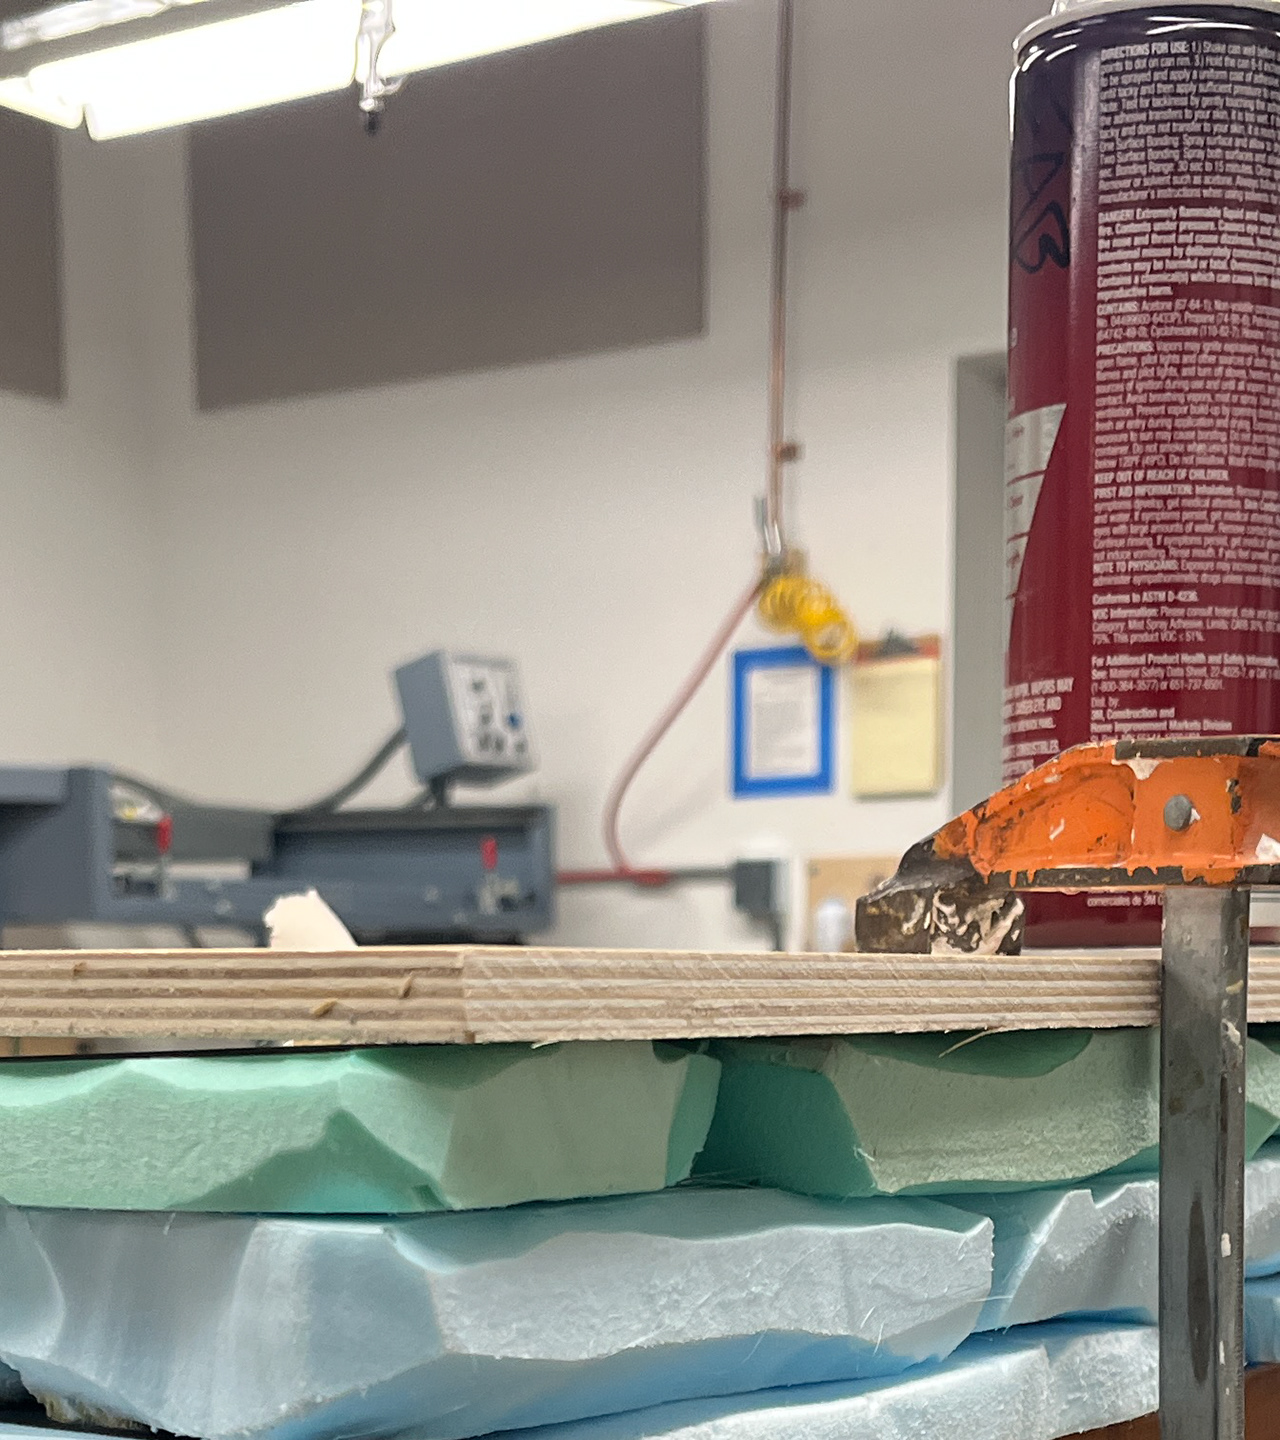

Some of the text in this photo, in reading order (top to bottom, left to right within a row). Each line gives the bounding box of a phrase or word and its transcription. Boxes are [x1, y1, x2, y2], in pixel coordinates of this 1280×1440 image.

[1095, 472, 1114, 484] KEEP
[1116, 471, 1132, 482] OUT
[1134, 470, 1144, 481] OF
[1147, 469, 1175, 480] REACH
[1176, 469, 1187, 480] OF
[1094, 486, 1116, 499] FIRST
[1118, 486, 1133, 497] AID
[1093, 562, 1113, 573] NOTE
[1116, 561, 1126, 572] TO
[1093, 594, 1130, 605] Conforms
[1132, 593, 1140, 602] to
[1142, 592, 1166, 602] ASTM
[1130, 632, 1159, 644] product
[1160, 630, 1177, 641] VOC
[1092, 656, 1104, 666] For
[1106, 654, 1146, 666] Additional
[1148, 654, 1179, 664] Product
[1181, 653, 1206, 664] Health
[1208, 654, 1222, 664] and
[1110, 668, 1140, 678] Material
[1142, 667, 1164, 678] Safety
[1167, 666, 1184, 677] Data
[1160, 681, 1168, 690] or
[1107, 708, 1157, 720] Construction
[1160, 708, 1174, 718] and
[1091, 719, 1232, 734] Home Improvement Markets Division
[1131, 895, 1142, 907] de
[1143, 893, 1157, 906] 3M
